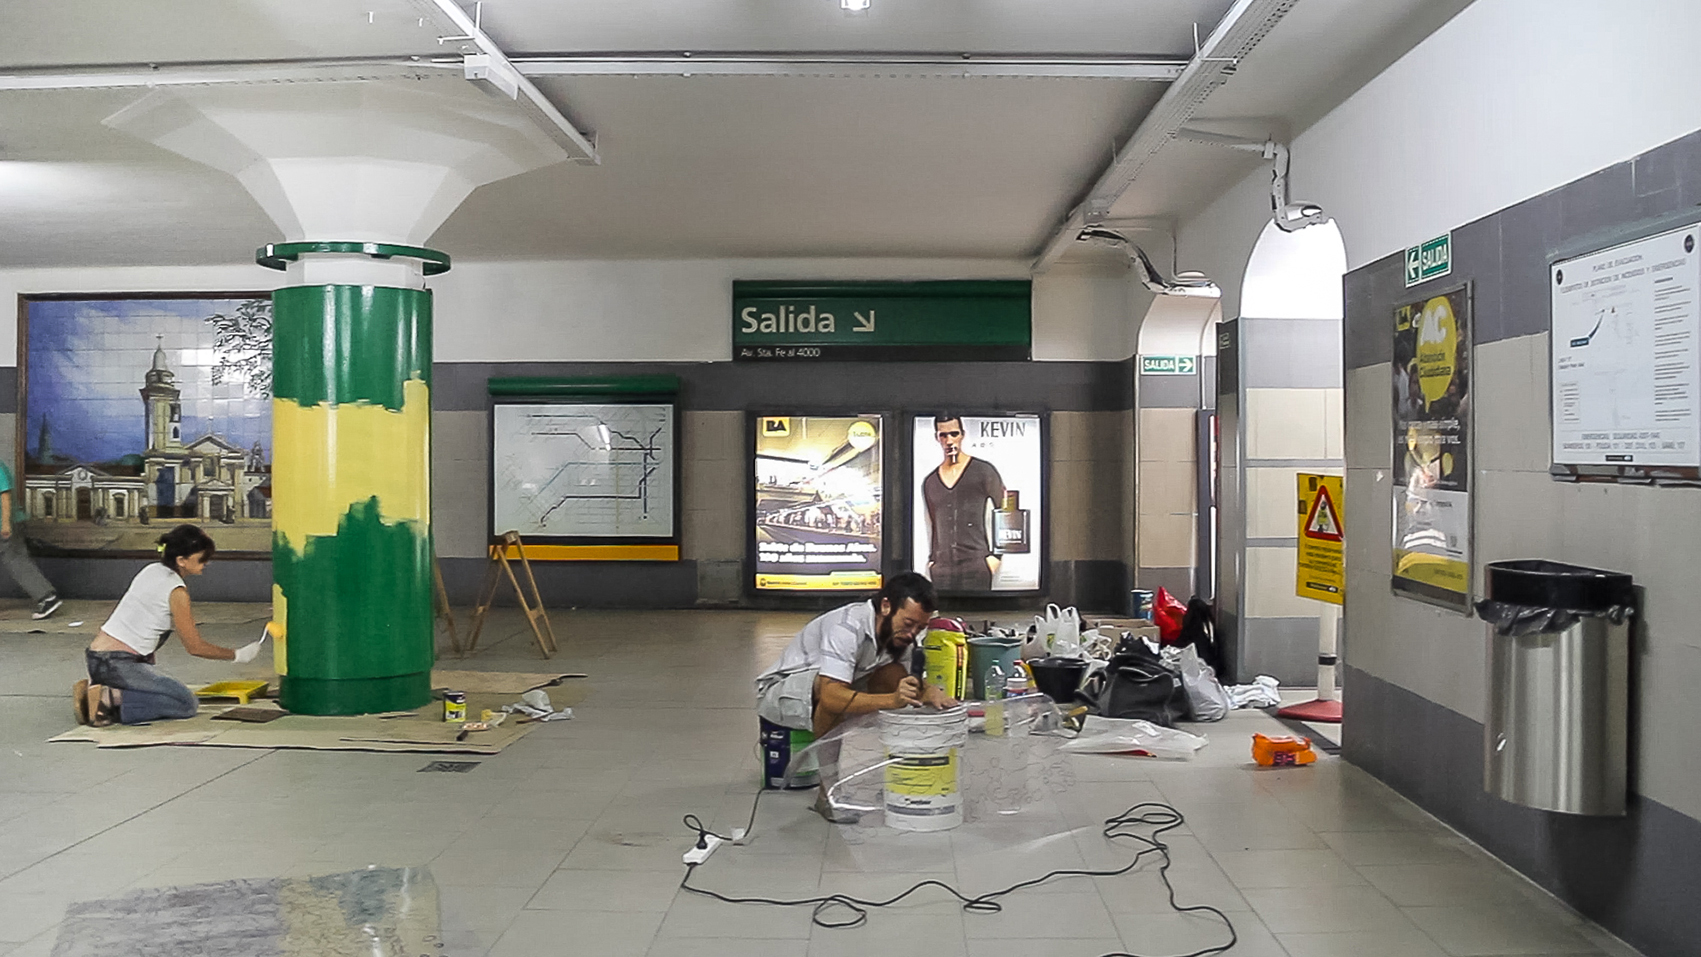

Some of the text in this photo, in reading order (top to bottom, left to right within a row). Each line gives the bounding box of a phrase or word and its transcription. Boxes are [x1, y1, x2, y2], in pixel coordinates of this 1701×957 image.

[741, 305, 835, 333] Salida
[1420, 305, 1447, 346] AC
[775, 348, 786, 357] Fe
[796, 347, 821, 357] 4000
[1144, 359, 1175, 370] SALIDA
[766, 420, 787, 431] BA
[980, 421, 1026, 438] KEVIN
